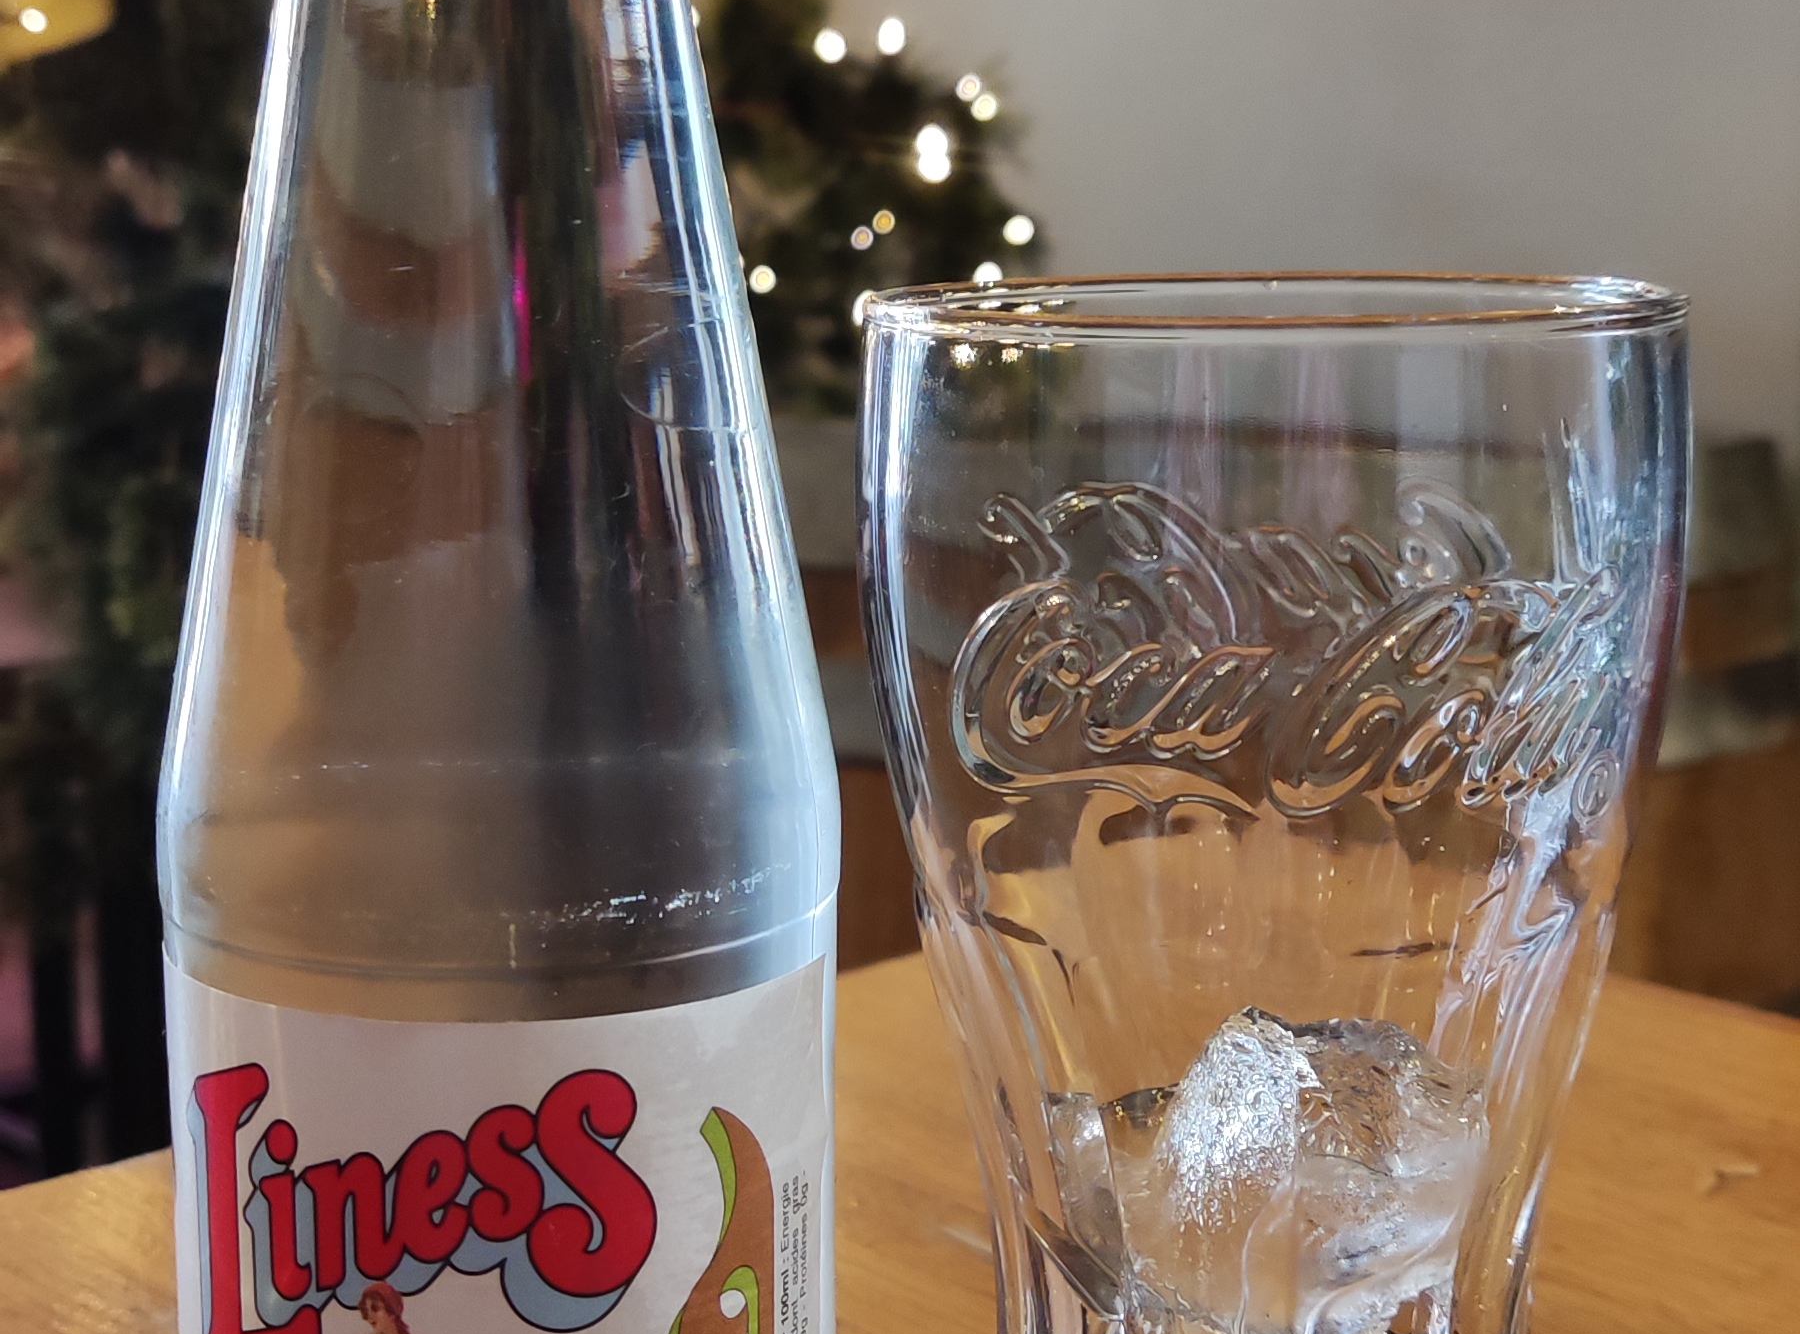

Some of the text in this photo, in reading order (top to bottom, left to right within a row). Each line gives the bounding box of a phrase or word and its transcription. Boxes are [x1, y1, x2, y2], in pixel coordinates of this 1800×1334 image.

[791, 1176, 801, 1215] gras
[791, 1227, 799, 1286] acides
[780, 1269, 789, 1326] 100ml
